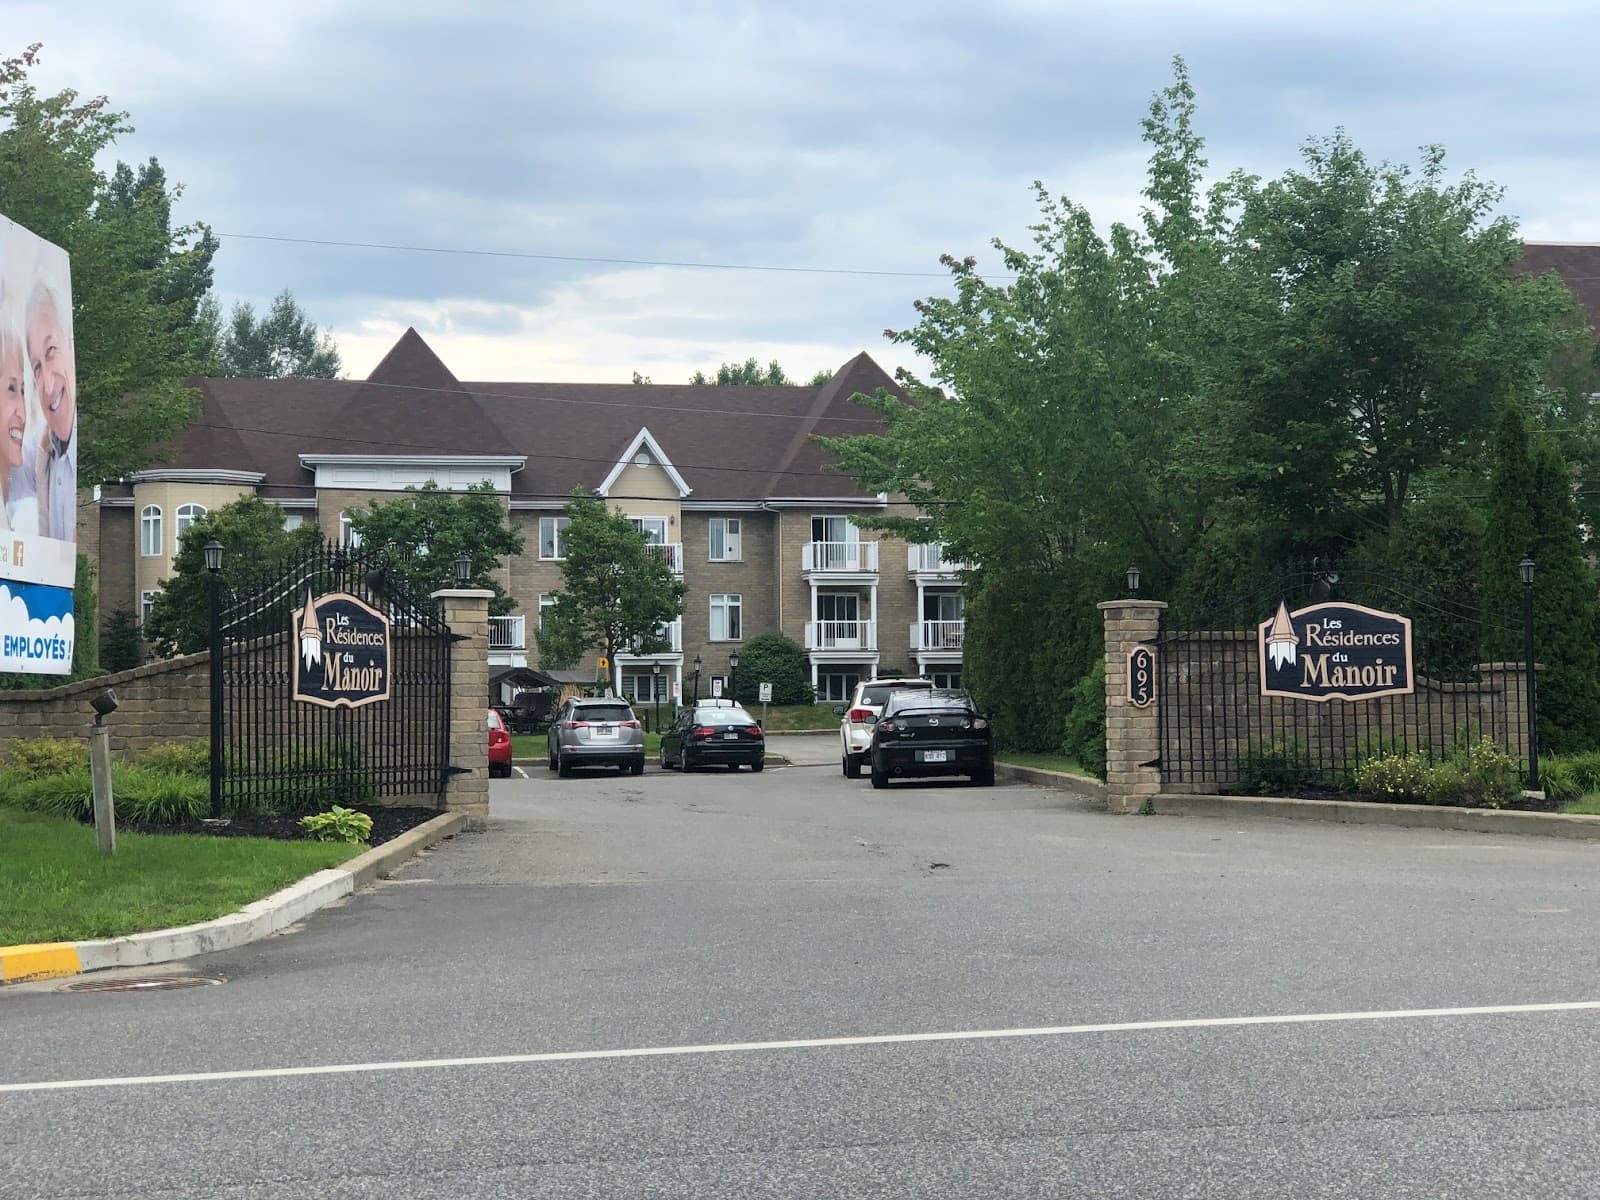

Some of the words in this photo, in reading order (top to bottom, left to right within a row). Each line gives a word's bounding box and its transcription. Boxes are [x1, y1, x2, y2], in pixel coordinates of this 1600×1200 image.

[337, 612, 349, 625] Les
[1323, 617, 1342, 629] Les
[326, 617, 384, 646] Résidences
[1306, 623, 1400, 647] Résidences
[343, 652, 354, 663] du
[1332, 652, 1348, 662] du
[321, 651, 382, 691] Manoir
[1137, 652, 1147, 704] 695
[1300, 653, 1397, 688] Manoir
